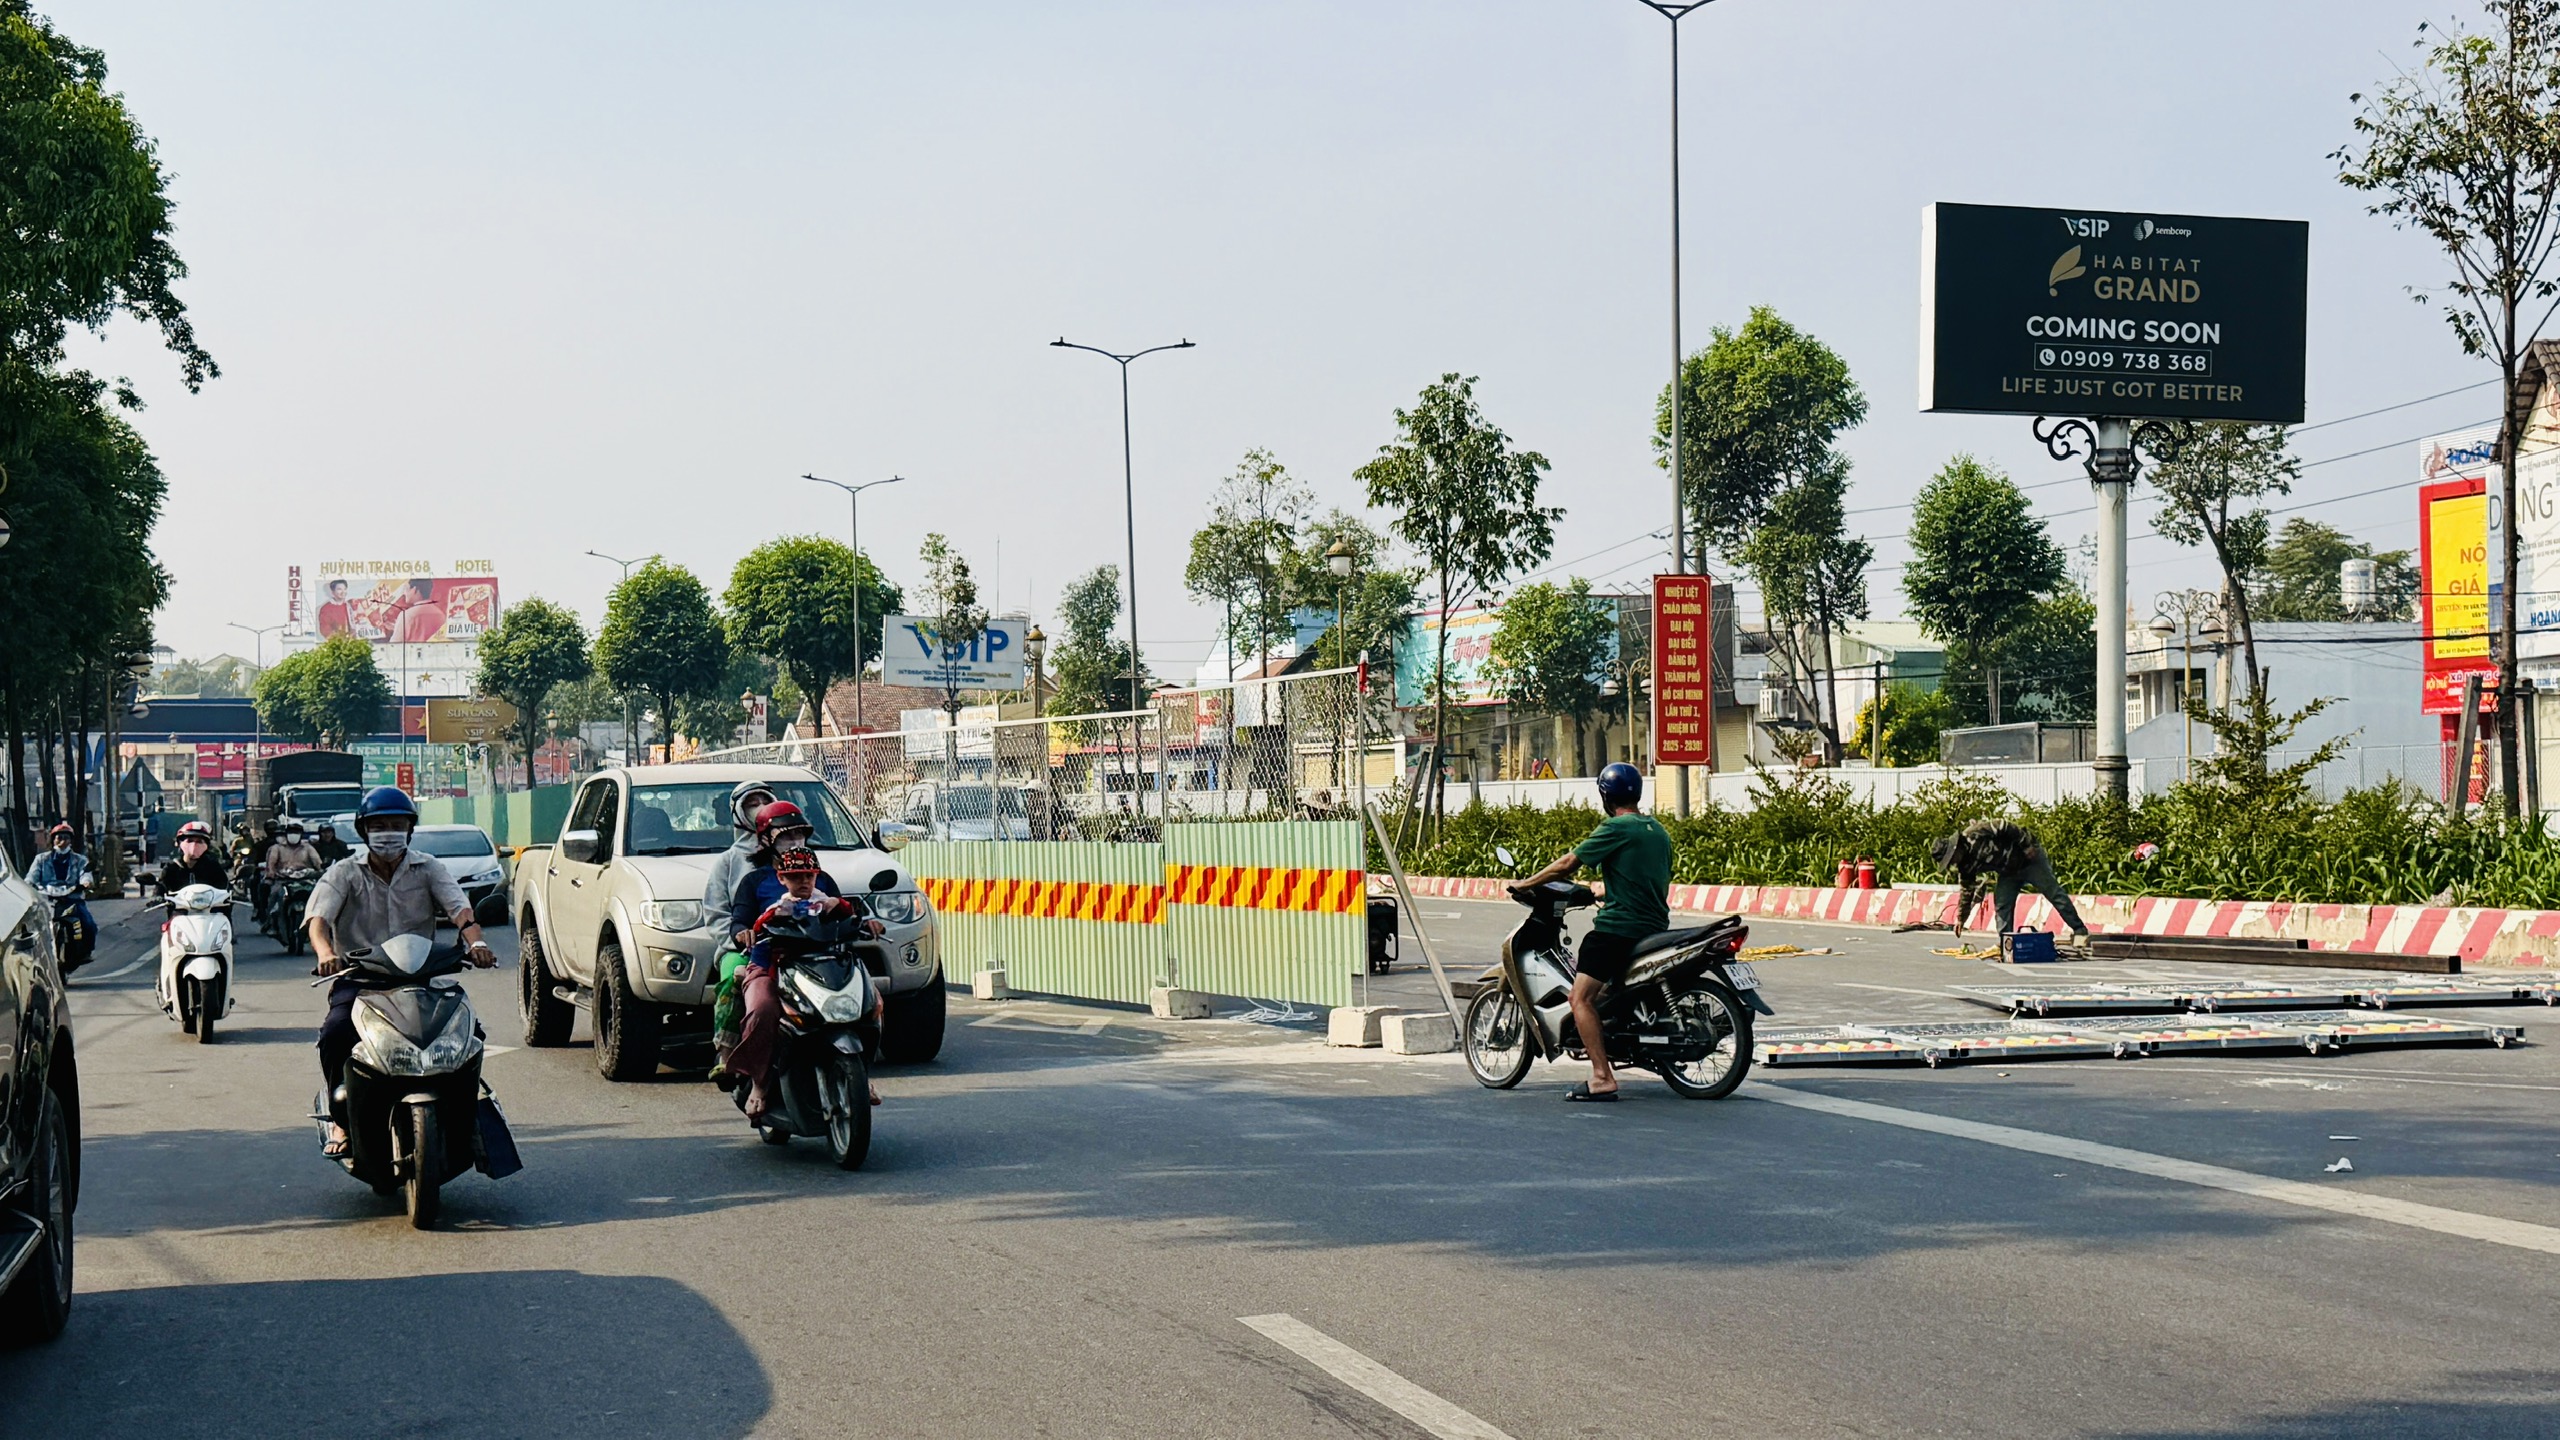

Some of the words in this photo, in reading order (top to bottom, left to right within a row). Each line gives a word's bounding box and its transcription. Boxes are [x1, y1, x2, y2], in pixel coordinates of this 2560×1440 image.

[2060, 217, 2110, 238] VSIP
[2155, 226, 2192, 238] sembcorp
[2093, 254, 2201, 273] HABITAT
[2093, 276, 2201, 303] GRAND
[2026, 315, 2136, 341] COMING
[2143, 320, 2221, 345] SOON
[2060, 349, 2114, 368] 0909
[2122, 352, 2160, 370] 738
[2168, 354, 2207, 371] 368
[2002, 376, 2047, 394] LIFE
[2053, 378, 2106, 396] JUST
[2112, 381, 2157, 399] GOT
[2163, 383, 2243, 402] BETTER
[320, 558, 365, 574] HUỲNH
[367, 560, 412, 574] TRANG
[414, 560, 431, 573] 68
[455, 559, 494, 573] HOTEL
[288, 565, 301, 622] HOTEL
[2448, 574, 2481, 596] GIÁ
[447, 708, 469, 718] SUN
[470, 708, 499, 718] CASA
